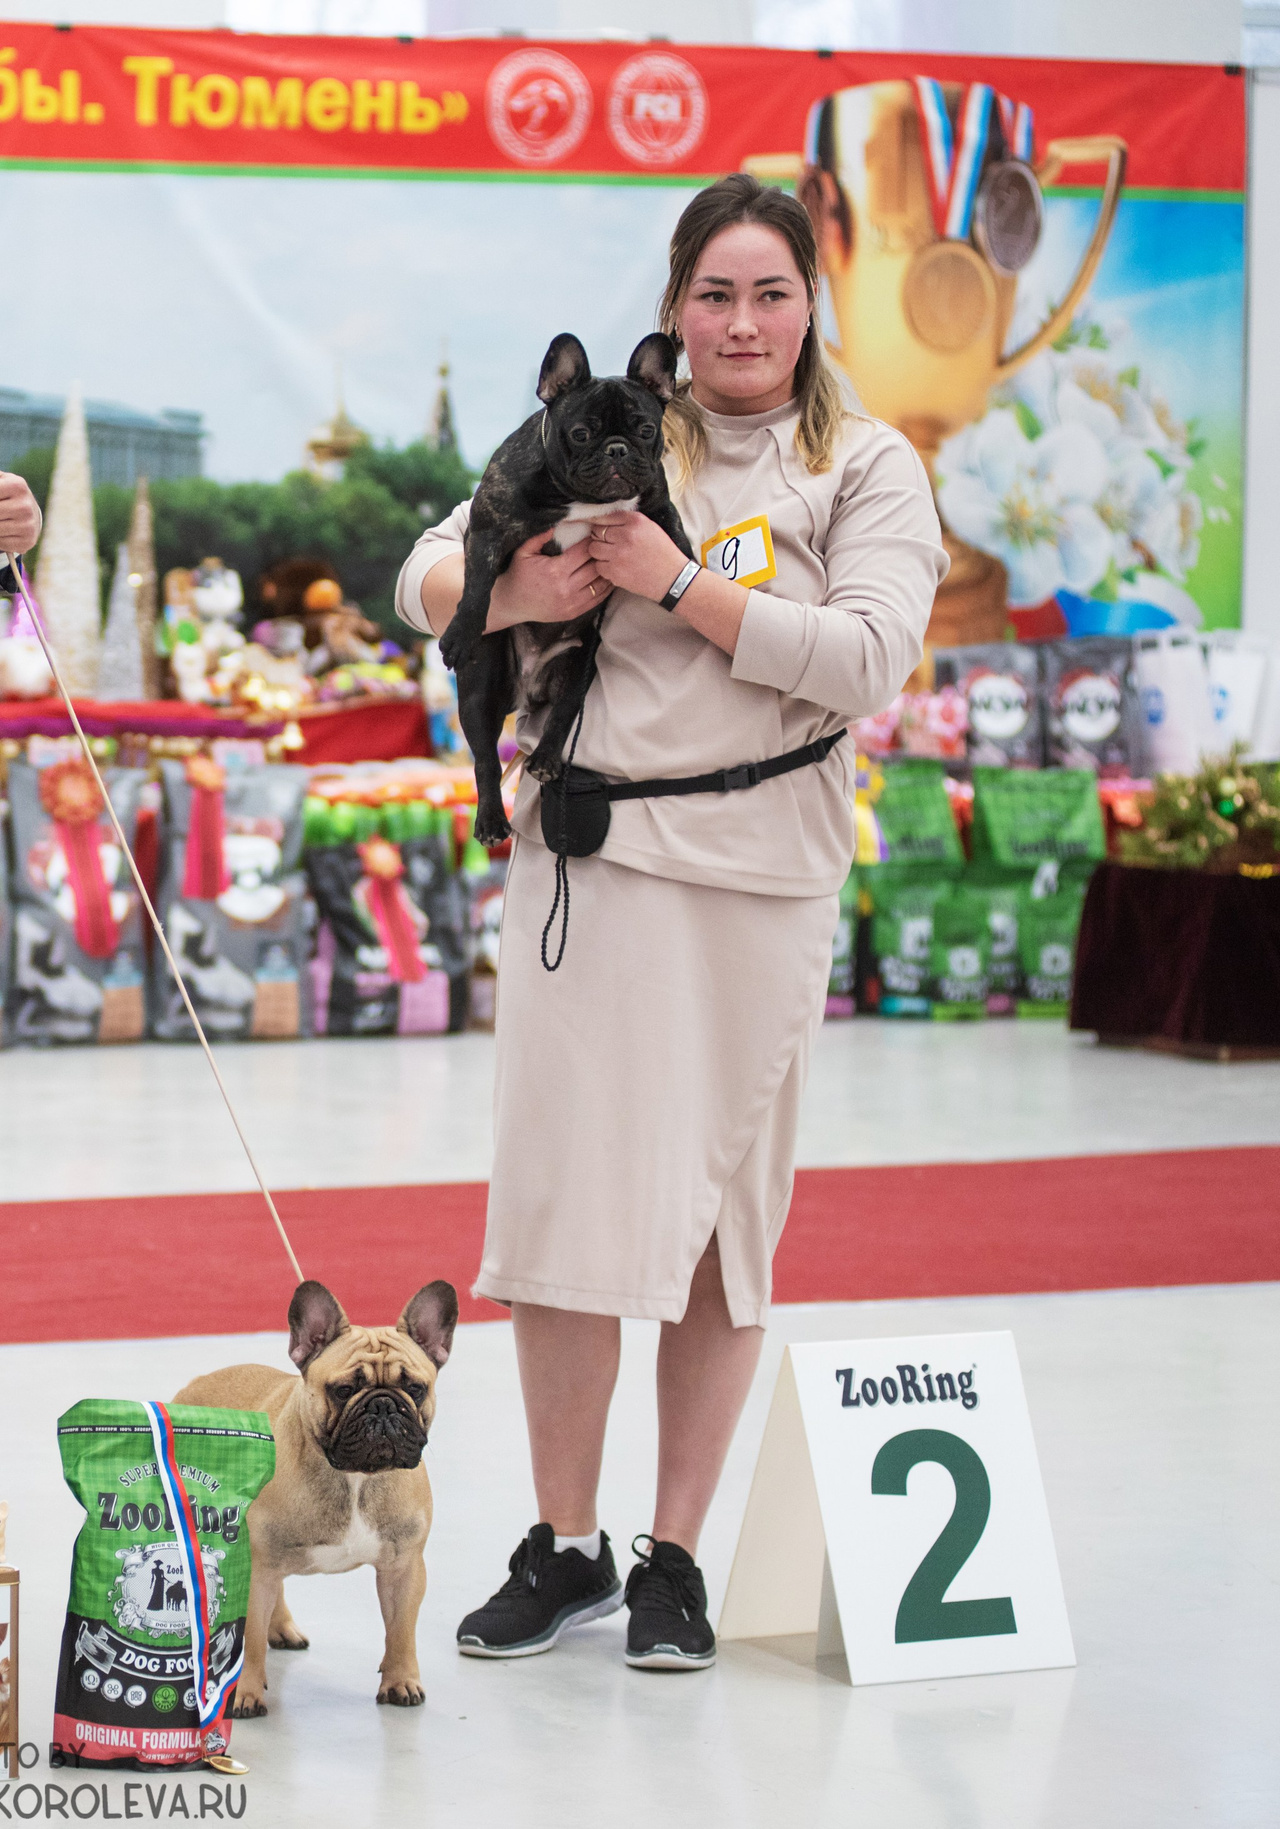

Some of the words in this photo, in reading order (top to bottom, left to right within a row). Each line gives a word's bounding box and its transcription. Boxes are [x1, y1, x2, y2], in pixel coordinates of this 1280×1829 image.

[123, 56, 469, 133] Тюмень»
[835, 1363, 979, 1411] ZooRing
[119, 1461, 160, 1488] SUPER
[180, 1464, 221, 1494] EMIUM
[871, 1428, 1018, 1644] 2
[119, 1648, 160, 1673] DOG
[165, 1656, 195, 1674] FOO
[75, 1722, 137, 1748] ORIGINAL
[142, 1731, 202, 1749] FORMULA
